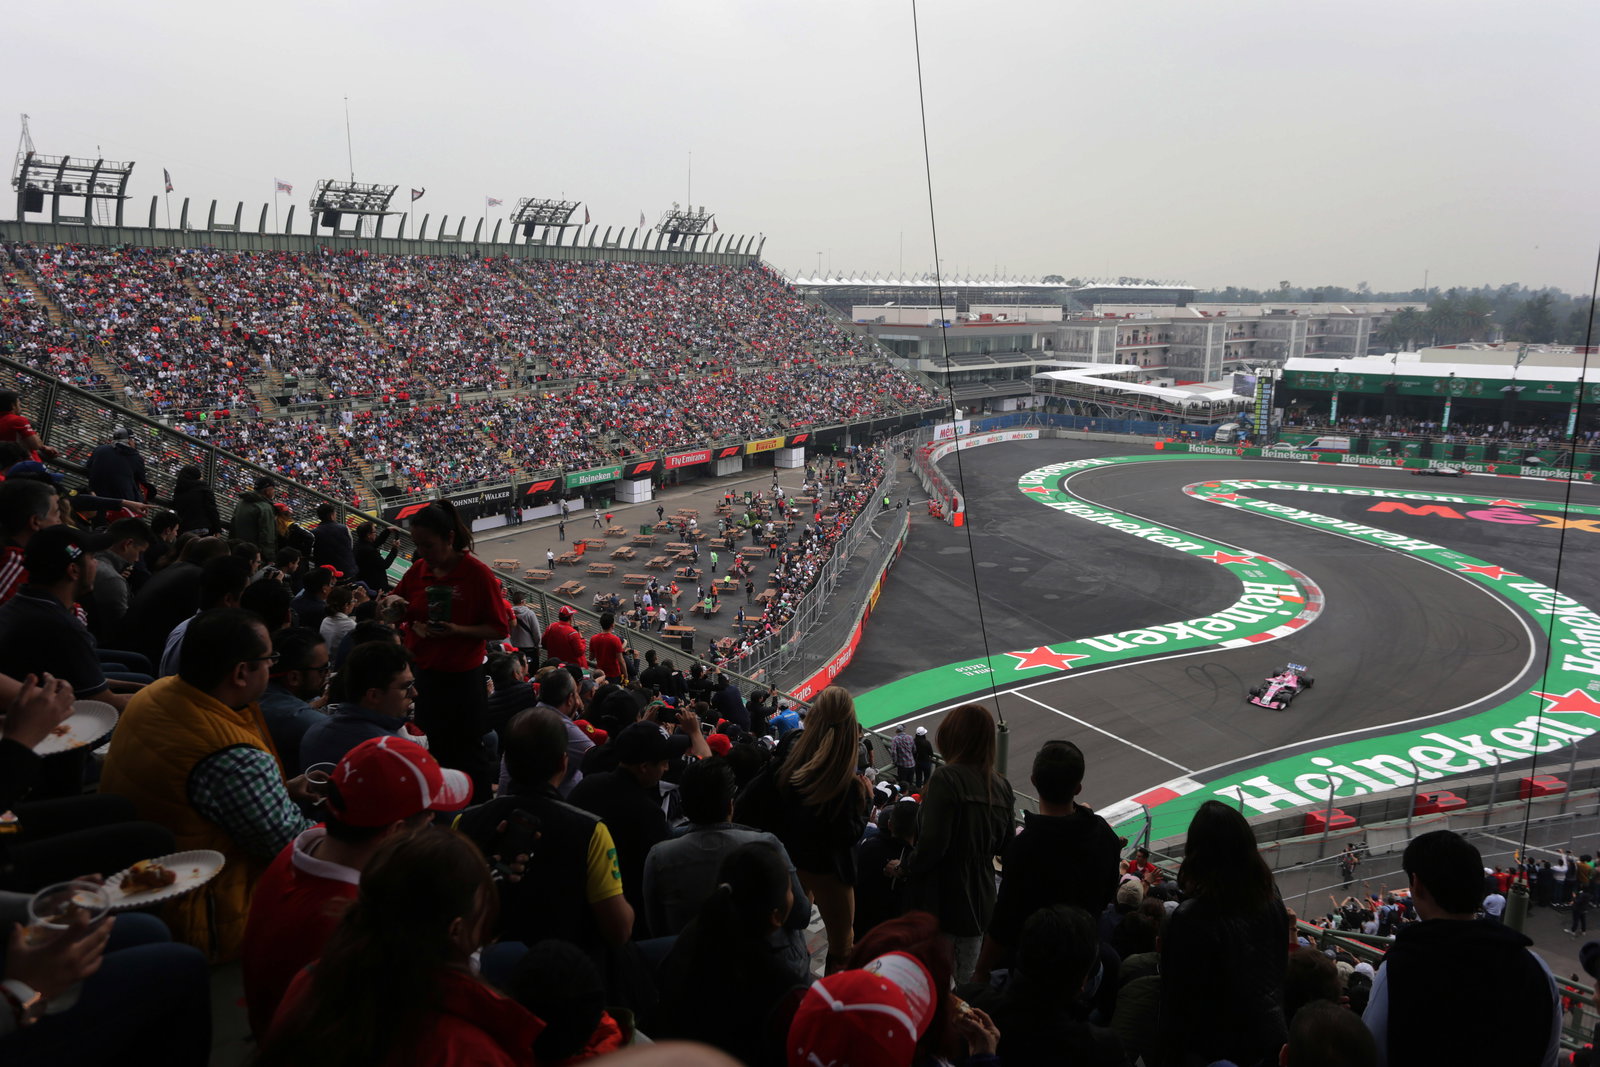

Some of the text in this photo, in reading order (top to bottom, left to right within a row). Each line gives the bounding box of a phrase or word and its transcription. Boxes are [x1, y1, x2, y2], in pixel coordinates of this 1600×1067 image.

[1188, 444, 1233, 455] Heineken
[1261, 448, 1308, 460] Heineken
[671, 453, 706, 466] Fly Emirates
[1341, 454, 1393, 466] Heineken
[1429, 459, 1483, 472] Heineken
[579, 472, 611, 484] Heineken
[1520, 466, 1580, 480] Heineken
[1222, 479, 1467, 503] Heineken
[1042, 501, 1205, 551] Heineken
[1245, 500, 1447, 551] Heineken
[1075, 580, 1302, 652] Heineken
[1214, 714, 1598, 813] Heineken
